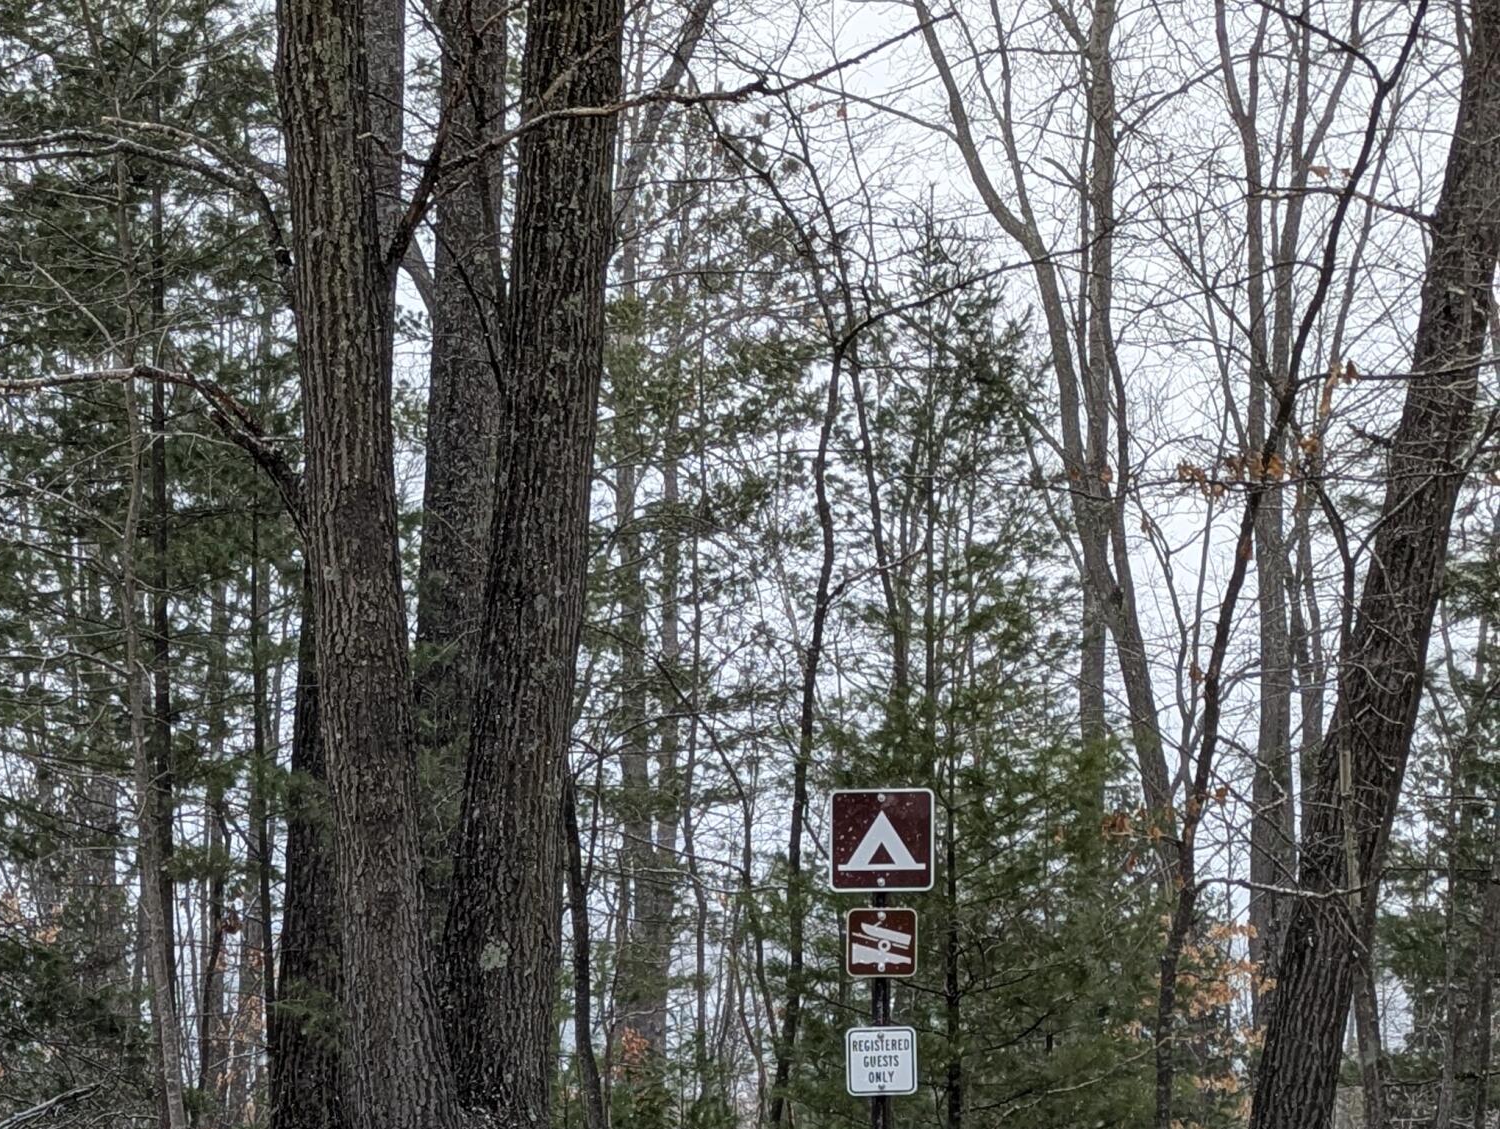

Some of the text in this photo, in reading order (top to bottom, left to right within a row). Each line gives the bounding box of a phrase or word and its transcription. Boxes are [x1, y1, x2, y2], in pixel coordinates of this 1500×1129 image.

[852, 1039, 910, 1052] REGISTERED
[863, 1055, 899, 1068] GUESTS
[868, 1071, 895, 1083] ONLY
